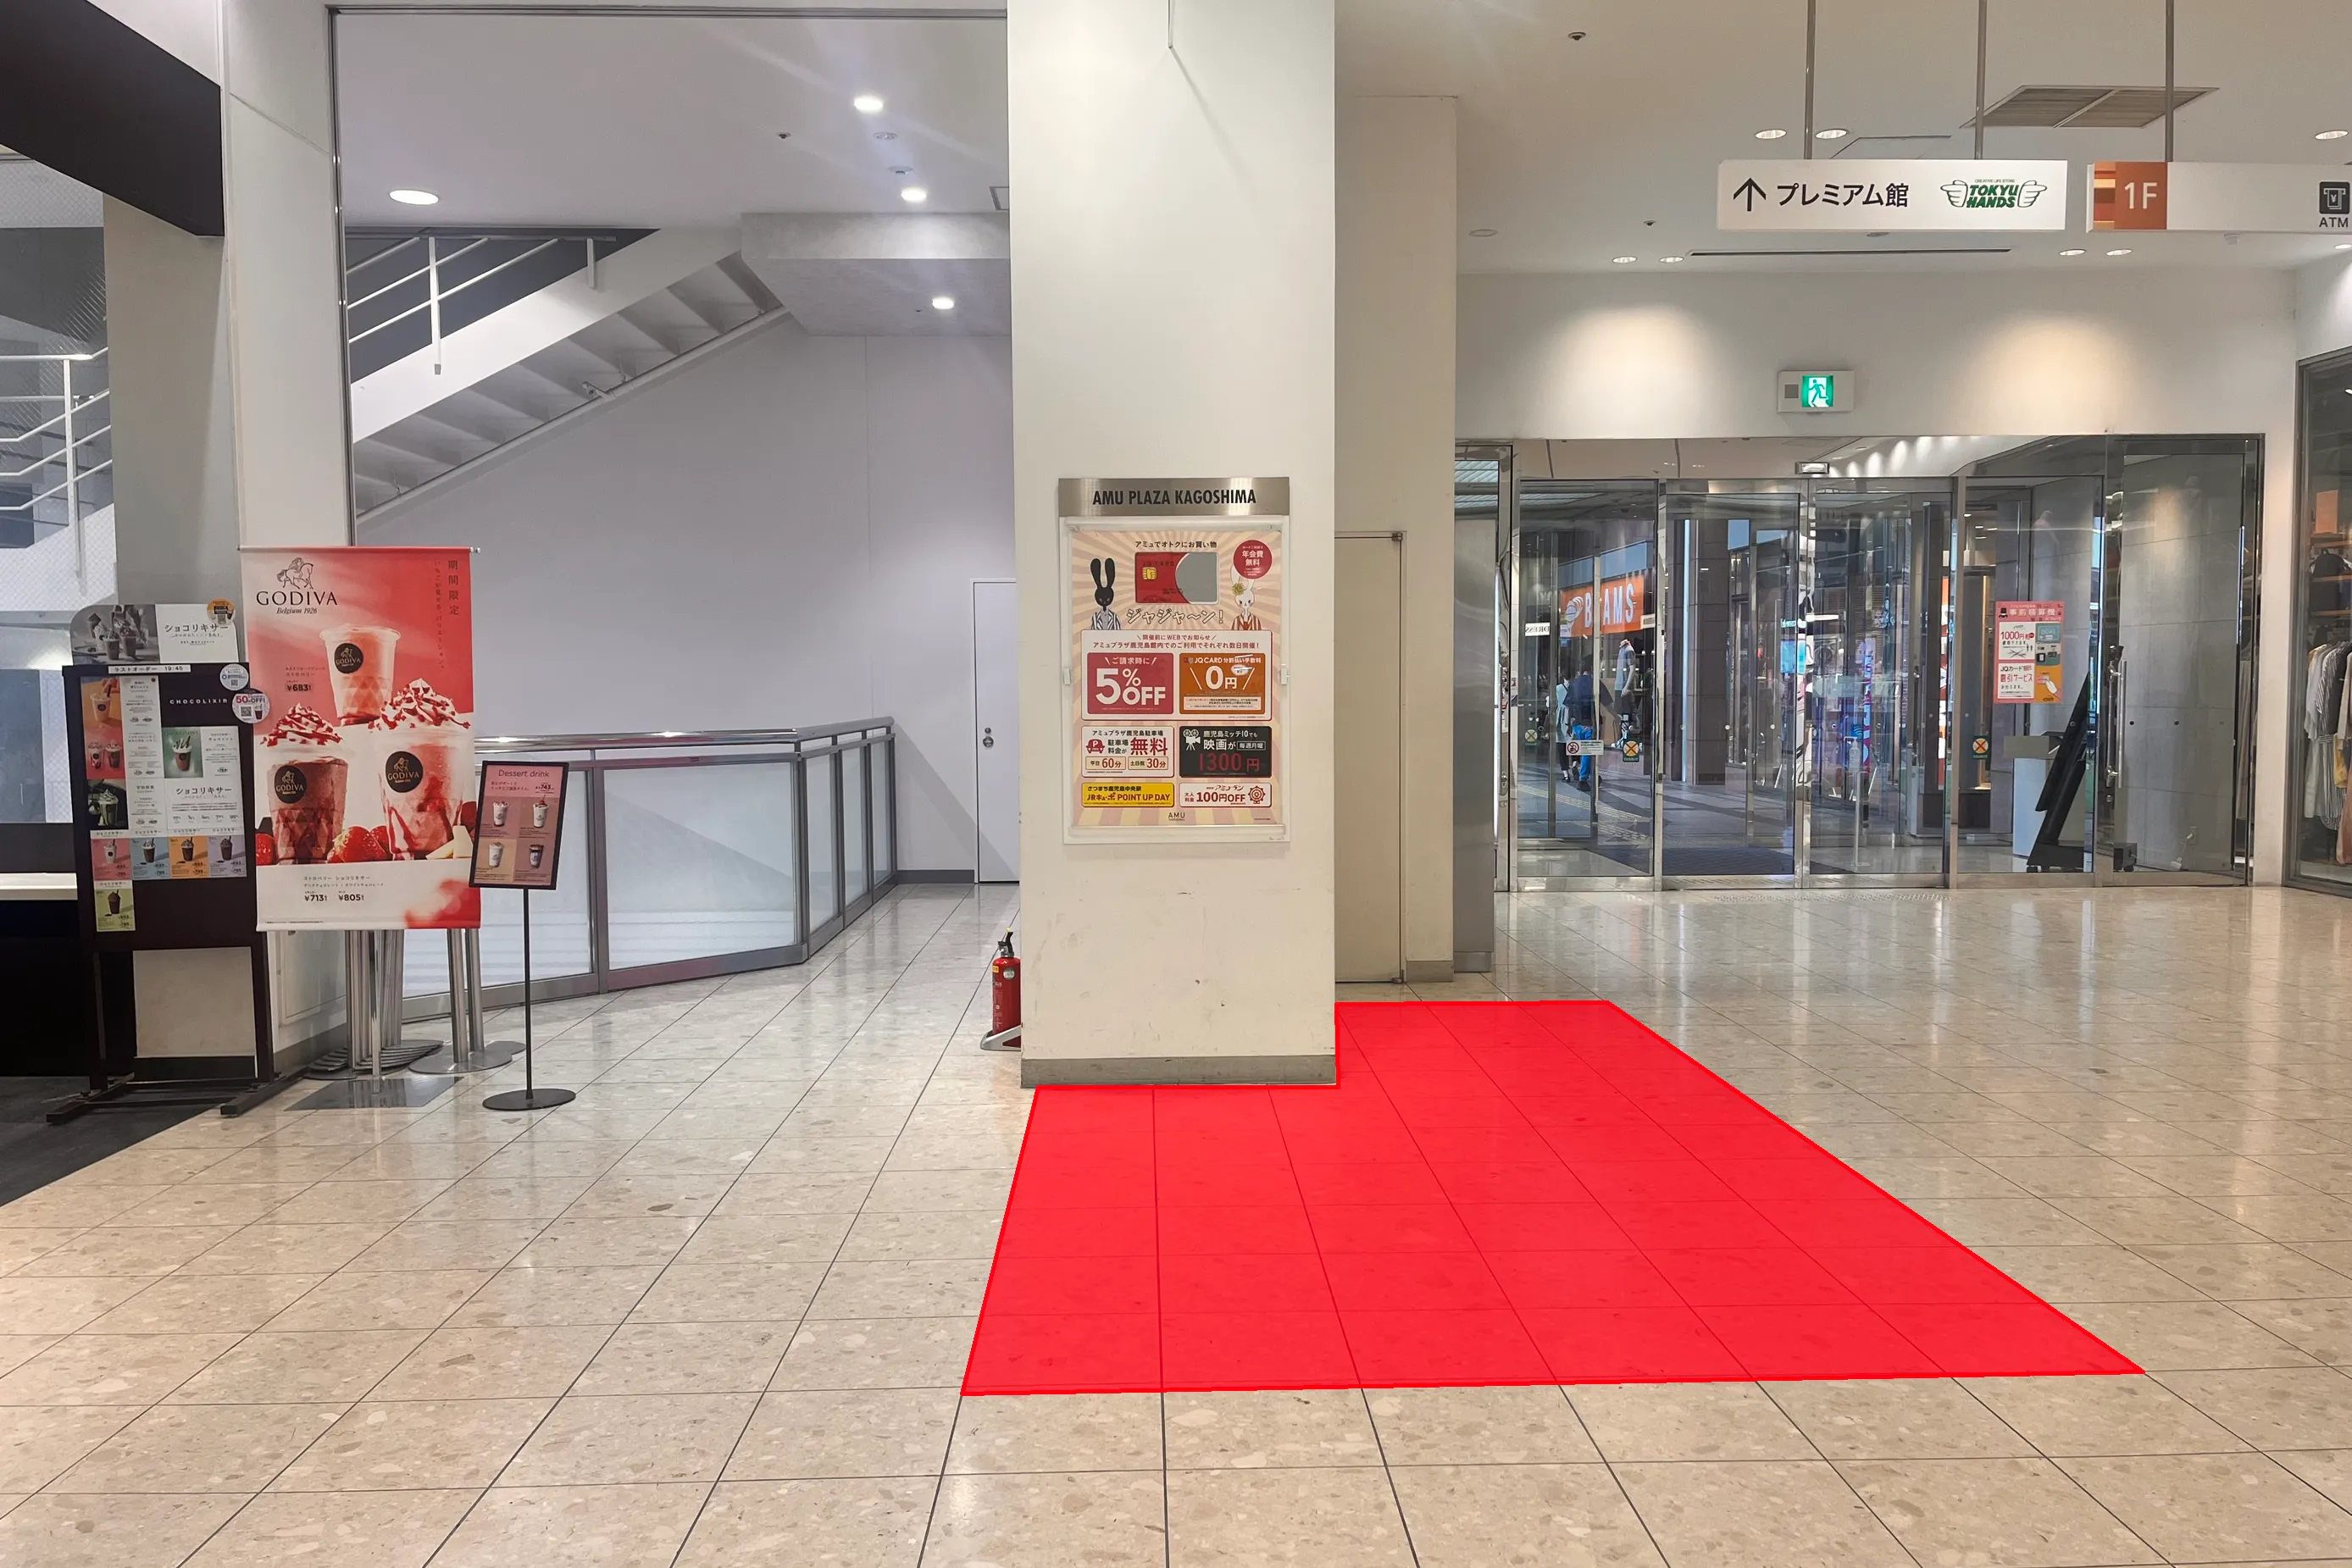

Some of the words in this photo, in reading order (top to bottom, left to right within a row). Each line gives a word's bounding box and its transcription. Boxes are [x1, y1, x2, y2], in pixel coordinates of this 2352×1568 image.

[1777, 182, 1909, 208] プレミアム館
[1970, 185, 2019, 196] TOKYU
[2124, 182, 2158, 209] 1F
[1966, 197, 2016, 208] HANDS
[2319, 217, 2349, 228] ATM
[1093, 490, 1123, 505] AMU
[1129, 490, 1170, 505] PLAZA
[1175, 490, 1256, 504] KAGOSHIMA
[1241, 550, 1264, 558] 年会費
[448, 560, 459, 615] 期間限定
[256, 590, 337, 606] GODIVA
[1585, 583, 1634, 628] BAMS
[164, 623, 228, 633] ショコリキサー
[1112, 657, 1150, 665] ご請求時に
[1205, 666, 1237, 690] 0円
[1096, 668, 1141, 705] 5%
[1123, 686, 1166, 705] OFF
[1130, 737, 1168, 756] 無料
[1203, 739, 1235, 751] 映画が
[1102, 758, 1121, 768] 60分
[1146, 758, 1166, 768] 30分
[1199, 752, 1260, 772] 1300円
[387, 772, 419, 781] GODIVA
[1196, 792, 1245, 802] 100円OFF
